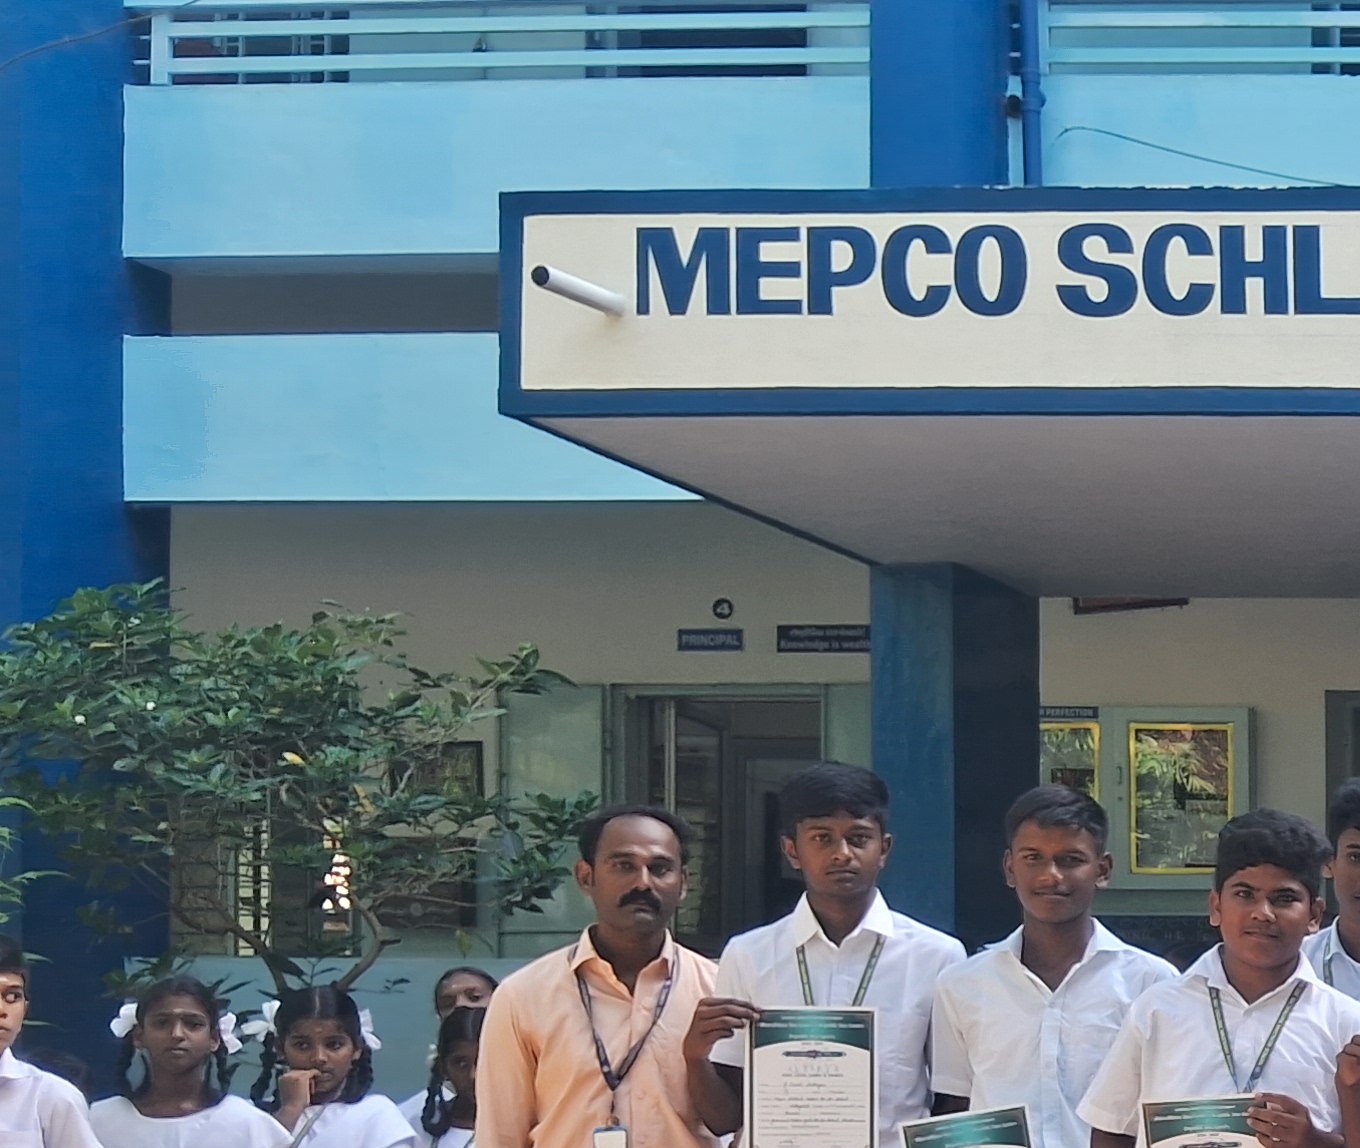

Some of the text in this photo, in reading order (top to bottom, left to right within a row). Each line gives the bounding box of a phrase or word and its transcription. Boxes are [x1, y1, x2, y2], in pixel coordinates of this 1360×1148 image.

[636, 223, 1029, 318] MEPCO
[716, 604, 731, 614] 4
[682, 634, 740, 646] PRINCIPAL
